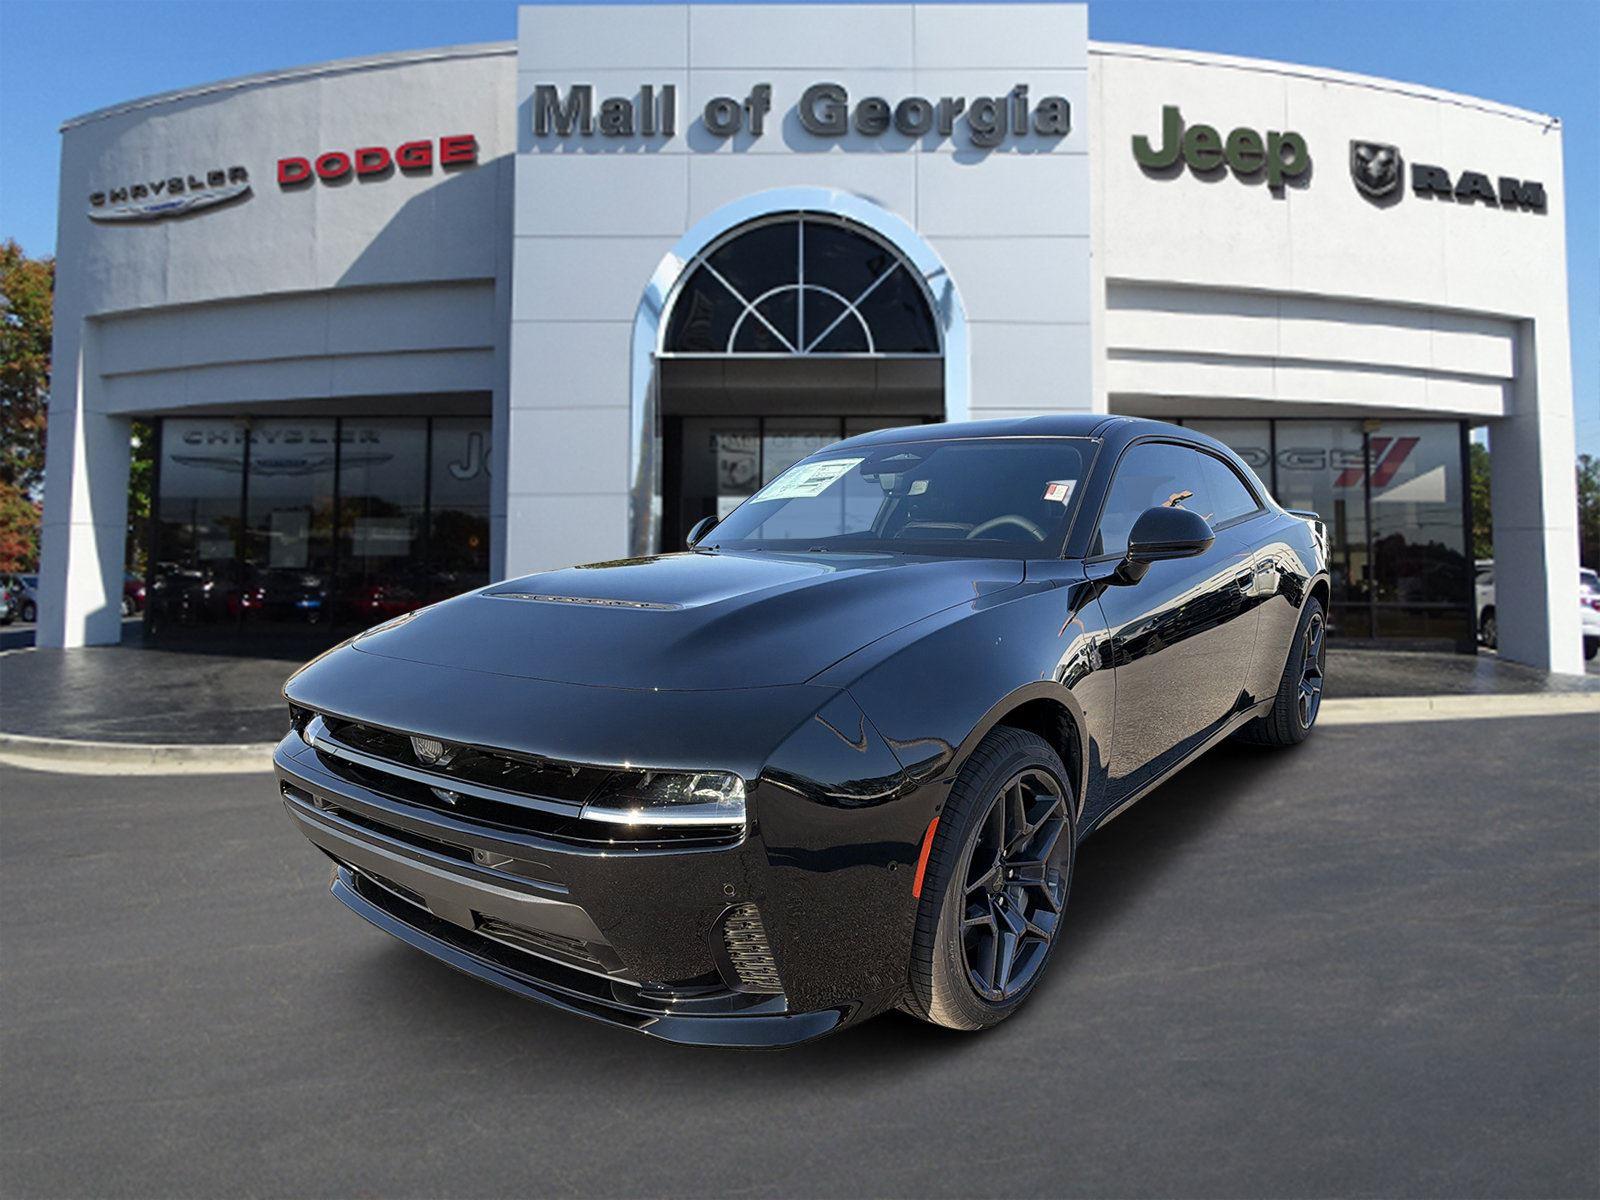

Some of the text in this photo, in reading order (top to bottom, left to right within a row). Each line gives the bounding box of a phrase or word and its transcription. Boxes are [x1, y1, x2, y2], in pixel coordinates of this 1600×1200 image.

[532, 83, 1073, 147] Mall of Georgia
[277, 134, 478, 187] DODGE
[1132, 105, 1310, 191] Jeep
[89, 165, 249, 206] CHRYSLER
[1411, 163, 1547, 212] RAM
[183, 430, 380, 445] CHRYSLER
